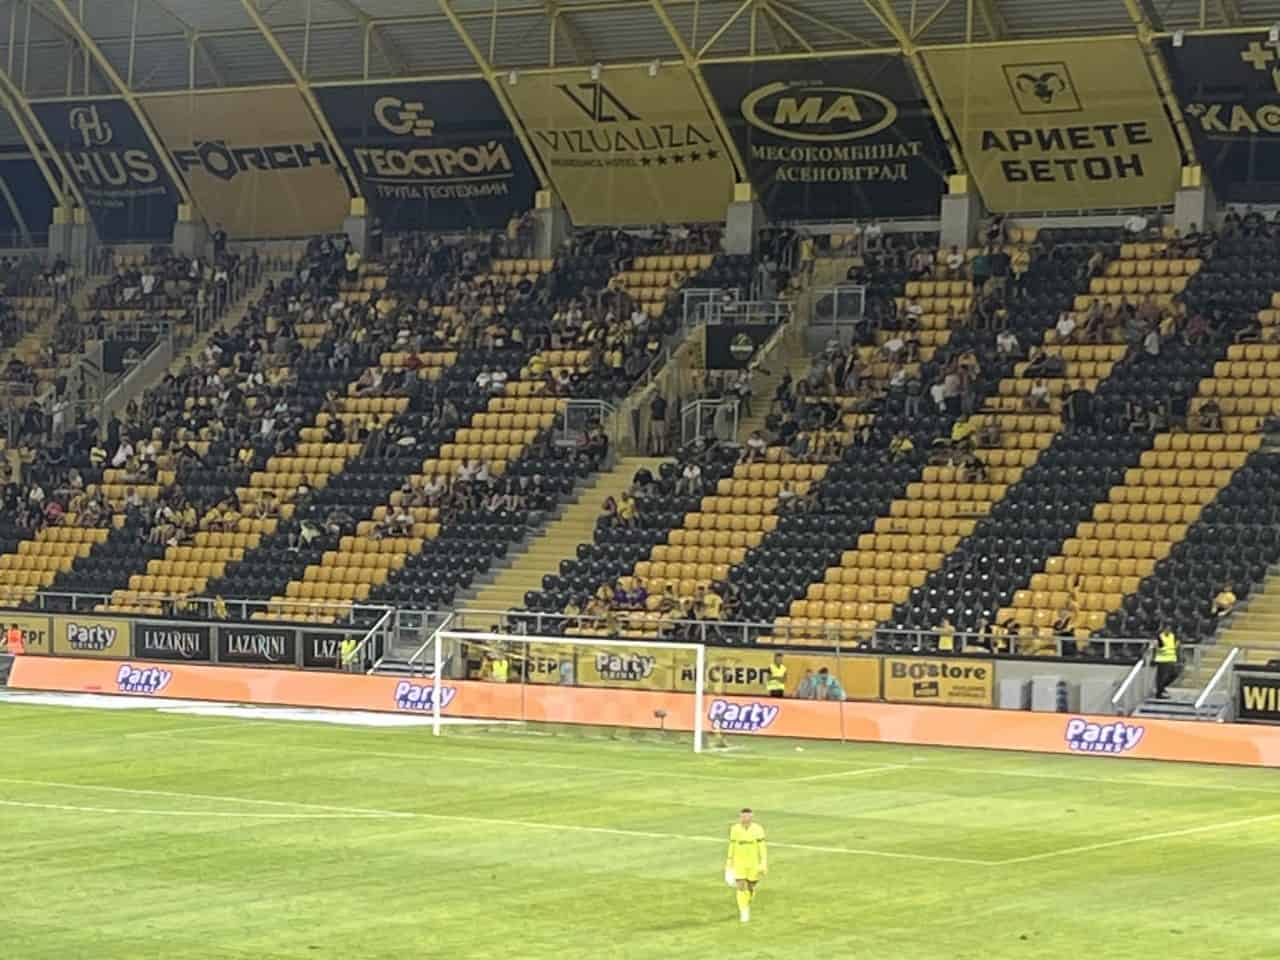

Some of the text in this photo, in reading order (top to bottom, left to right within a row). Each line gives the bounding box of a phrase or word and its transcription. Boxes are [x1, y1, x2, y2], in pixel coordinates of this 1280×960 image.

[536, 123, 712, 153] VIZUALIZA
[981, 122, 1152, 152] АРИЕТЕ
[353, 140, 512, 176] ГЕОСТРОЙ
[752, 141, 922, 162] МЕСОКОМБИНАТ
[65, 150, 158, 184] HUS
[776, 163, 908, 182] АСЕНОВГРАД
[1001, 154, 1144, 183] БЕТОН
[67, 623, 115, 647] Party
[144, 630, 200, 657] LAZARINI
[228, 633, 285, 662] LAZARINI
[117, 665, 171, 690] Party
[596, 652, 655, 677] Party
[710, 700, 778, 728] Party
[1067, 719, 1144, 750] Party
